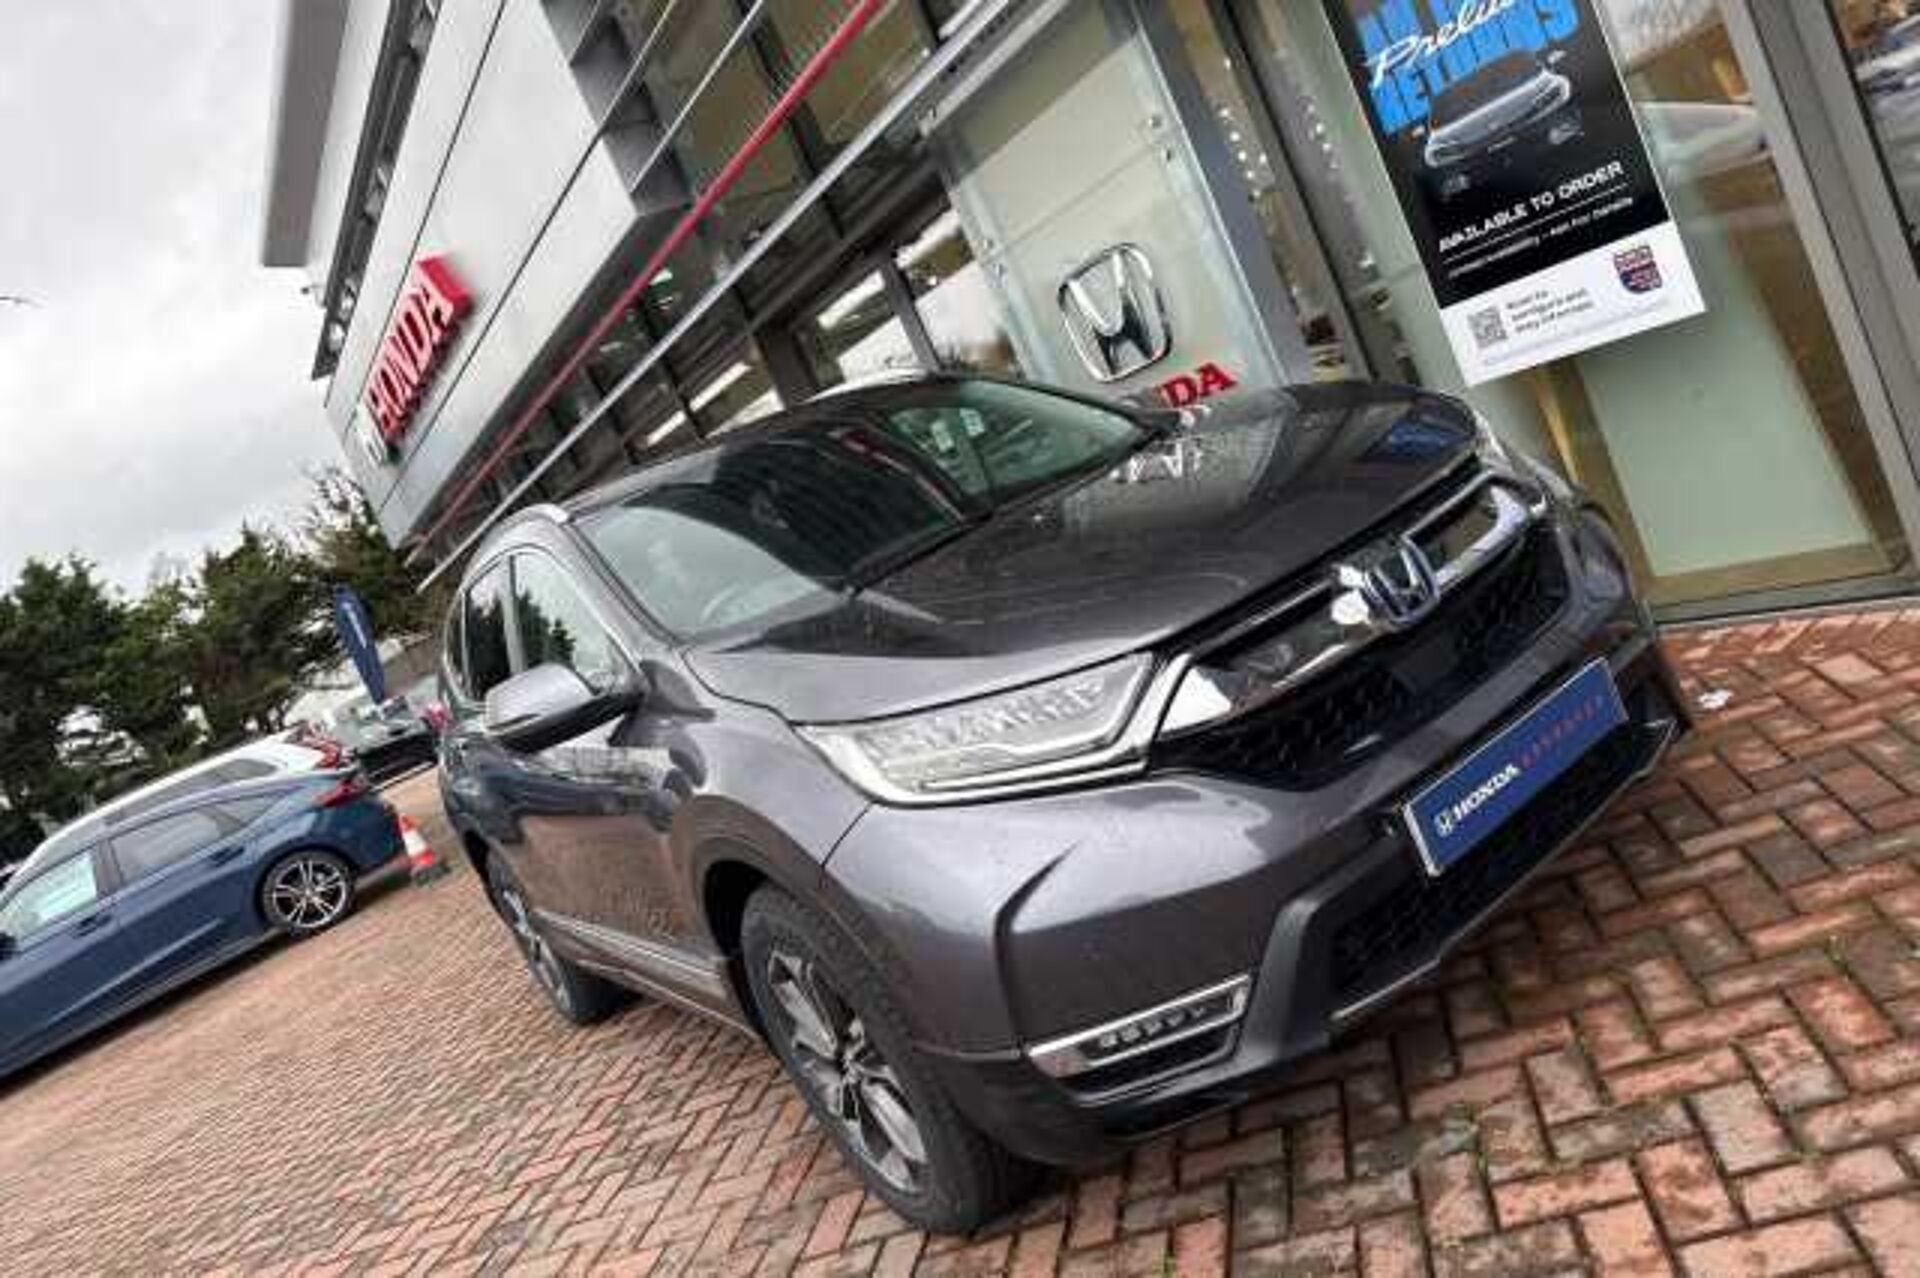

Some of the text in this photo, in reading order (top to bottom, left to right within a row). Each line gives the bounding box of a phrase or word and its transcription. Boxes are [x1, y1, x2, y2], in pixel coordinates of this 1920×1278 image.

[1439, 202, 1528, 252] AVAILABLE
[1530, 191, 1555, 211] TO
[1558, 160, 1624, 199] ORDER
[364, 255, 474, 441] HONDA
[1452, 763, 1521, 822] HONDA
